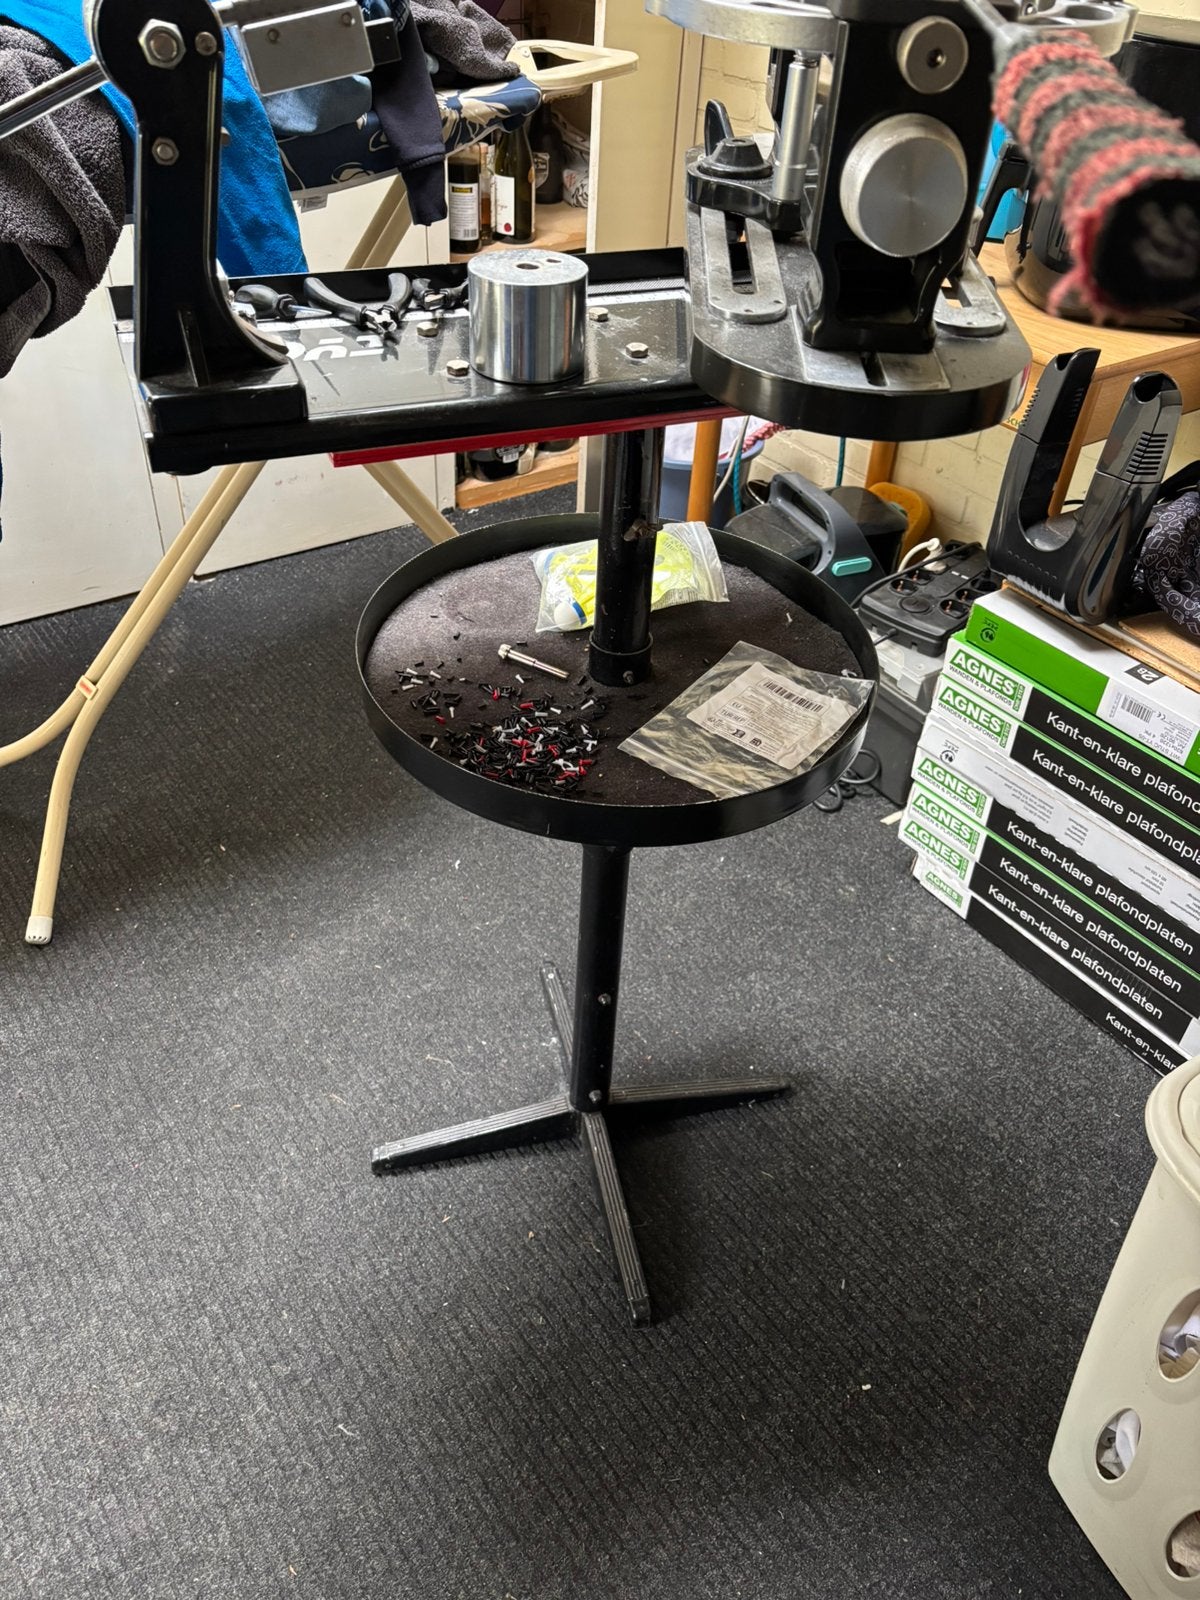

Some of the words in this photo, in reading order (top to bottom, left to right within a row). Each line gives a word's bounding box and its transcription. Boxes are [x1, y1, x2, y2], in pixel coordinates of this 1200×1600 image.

[949, 665, 975, 685] WANDEN
[980, 683, 1013, 707] PLAFONDS
[953, 651, 1016, 696] AGNES
[937, 702, 963, 722] WANDEN
[967, 720, 999, 744] PLAFONDS
[941, 689, 1002, 734] AGNES
[1046, 711, 1142, 778] Kant-en-klare
[920, 759, 978, 805] AGNES
[945, 790, 976, 813] PLAFONDS
[1032, 749, 1124, 815] Kant-en-klare
[914, 796, 971, 840] AGNES
[939, 825, 969, 849] PLAFONDS
[905, 822, 960, 870] AGNES
[927, 872, 958, 901] AGNES
[1006, 820, 1094, 887] Kant-en-klare
[1095, 883, 1194, 956] plafondplaten
[999, 857, 1084, 924] Kant-en-klare
[1086, 919, 1182, 994] plafondplaten
[988, 884, 1070, 951] Kant-en-klare
[1071, 947, 1164, 1020] plafondplaten
[1105, 1011, 1176, 1071] Kant-en-klar
